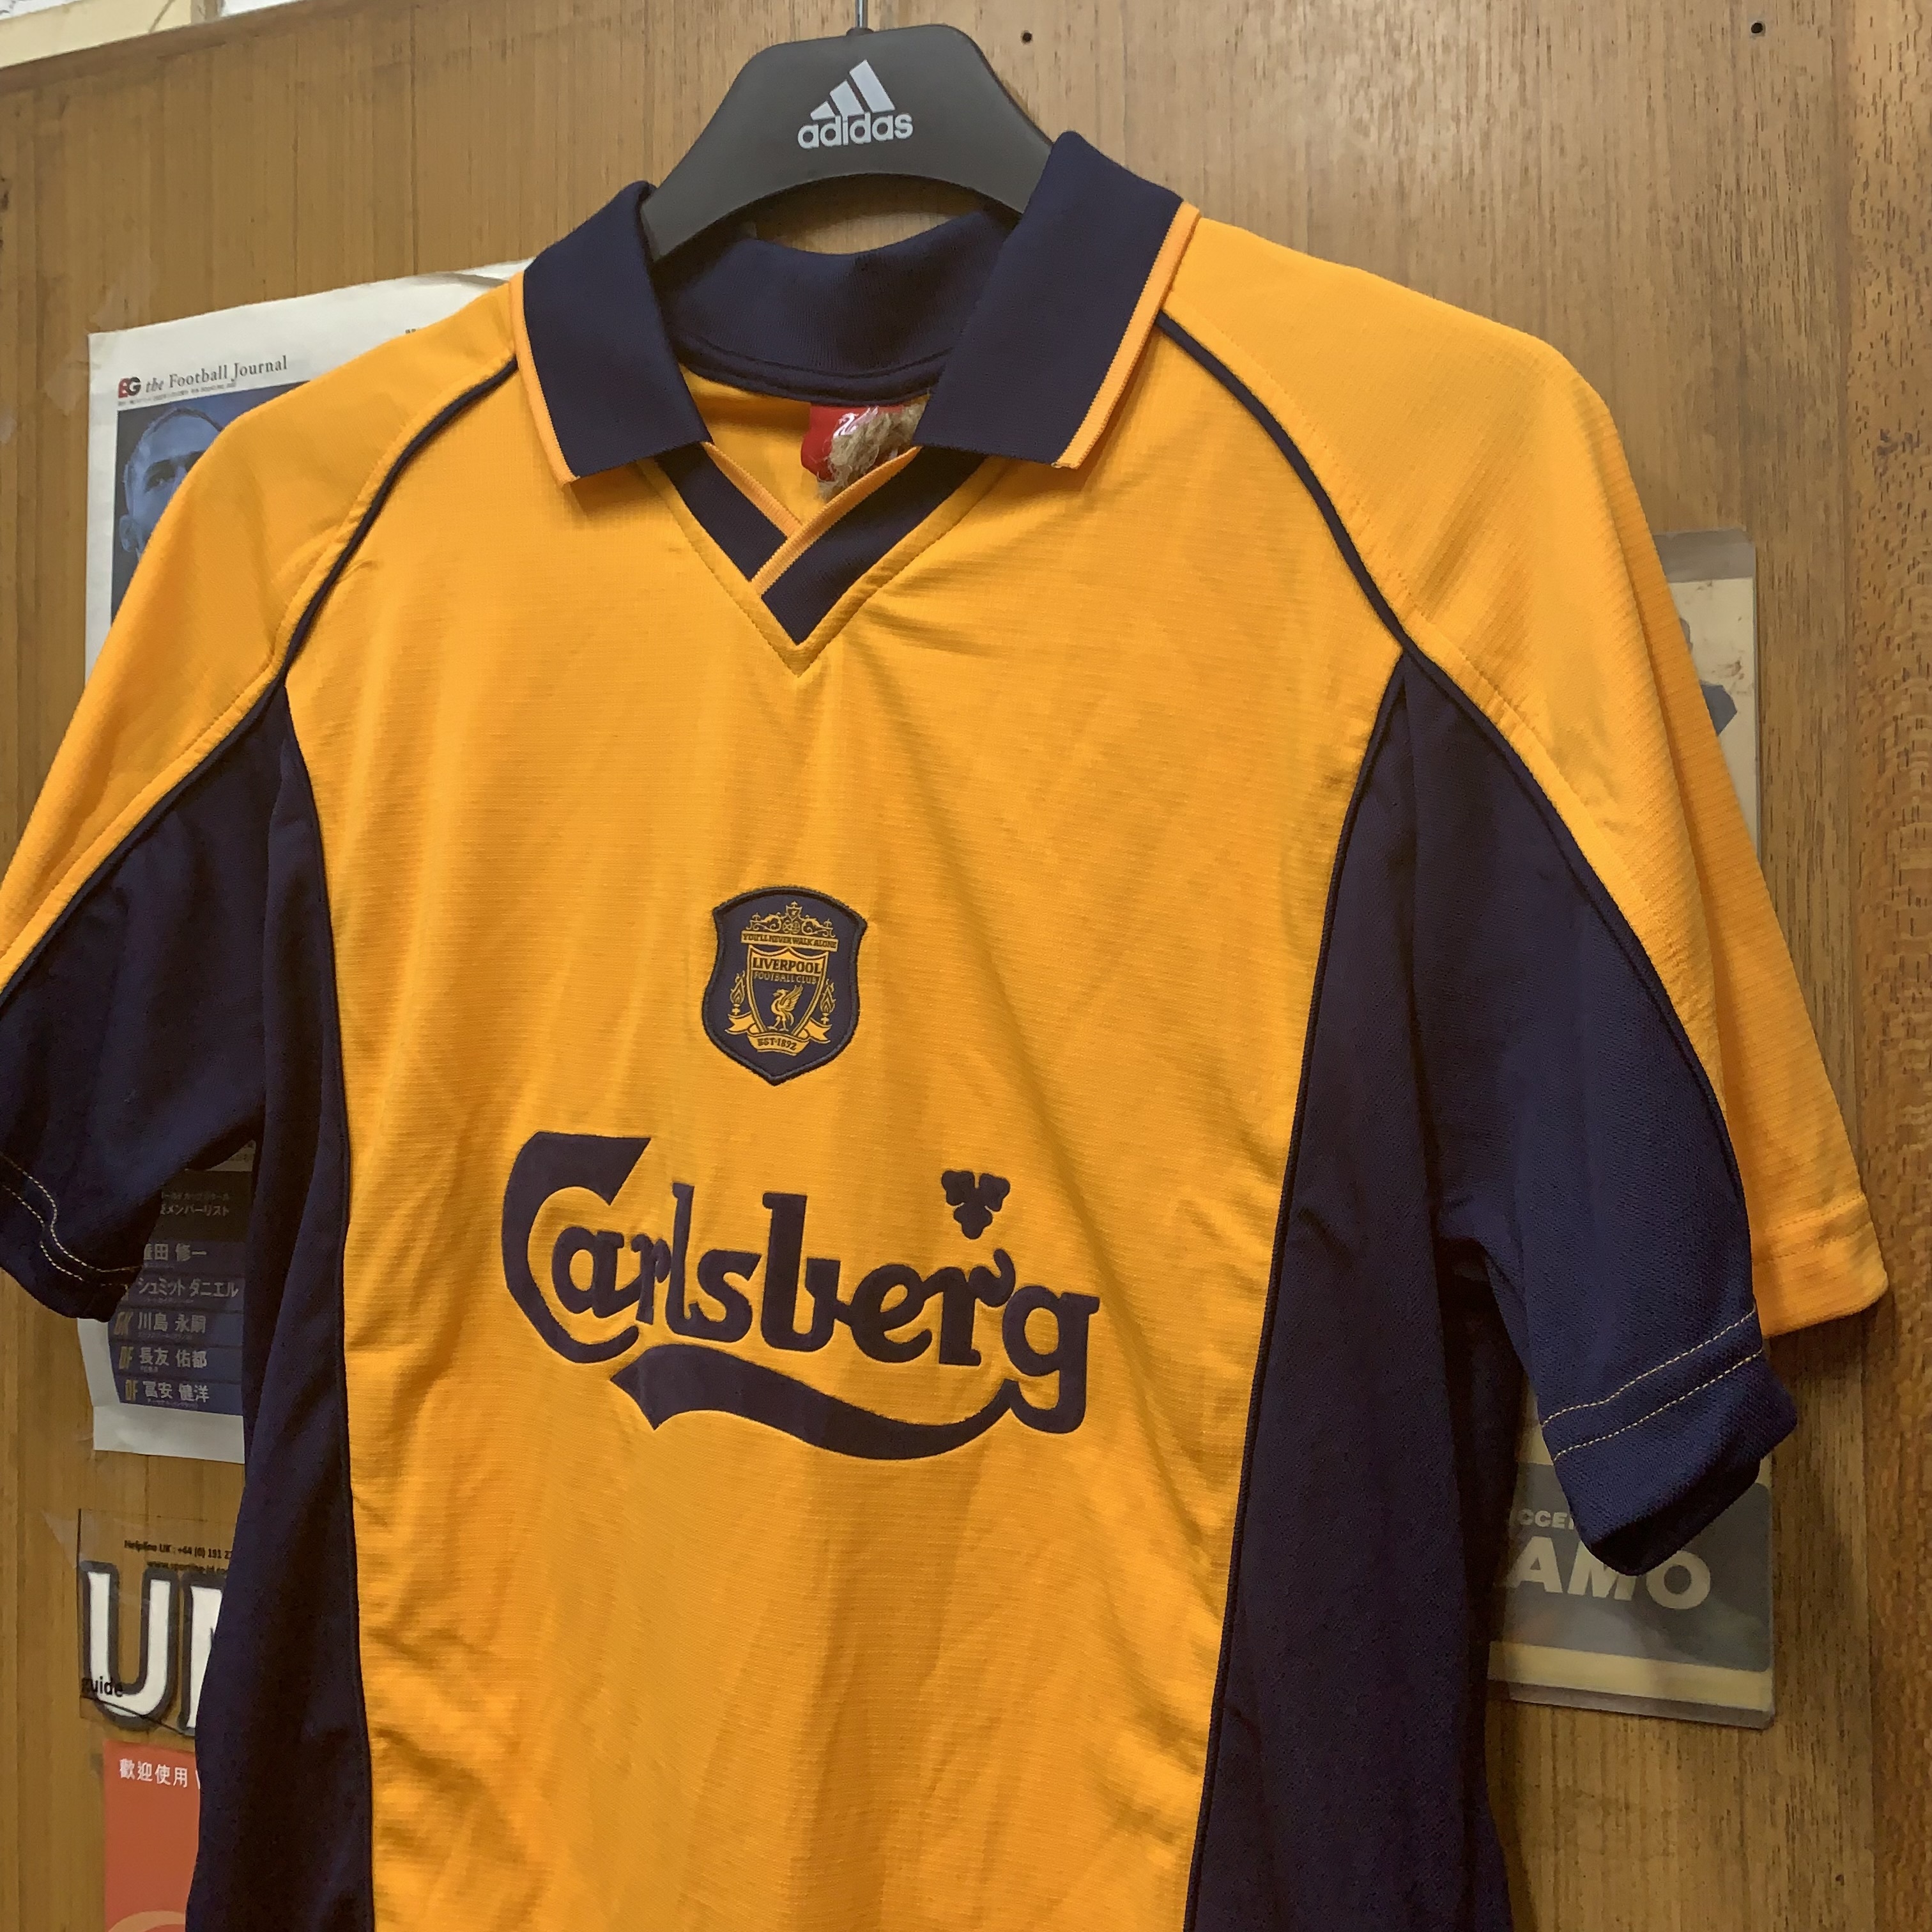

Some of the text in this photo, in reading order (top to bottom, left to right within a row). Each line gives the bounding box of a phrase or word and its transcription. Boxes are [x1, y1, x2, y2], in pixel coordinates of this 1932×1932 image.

[798, 112, 913, 149] adidas
[146, 377, 164, 393] the
[169, 364, 227, 388] Football
[231, 355, 288, 381] Journal
[753, 957, 822, 974] LIVERPOOL
[754, 971, 817, 985] FOOTBALL CLUB
[189, 1278, 239, 1298] ダニエル
[501, 1131, 1100, 1460] Carlsberg
[138, 1312, 168, 1332] 川島
[139, 1347, 169, 1366] 長友
